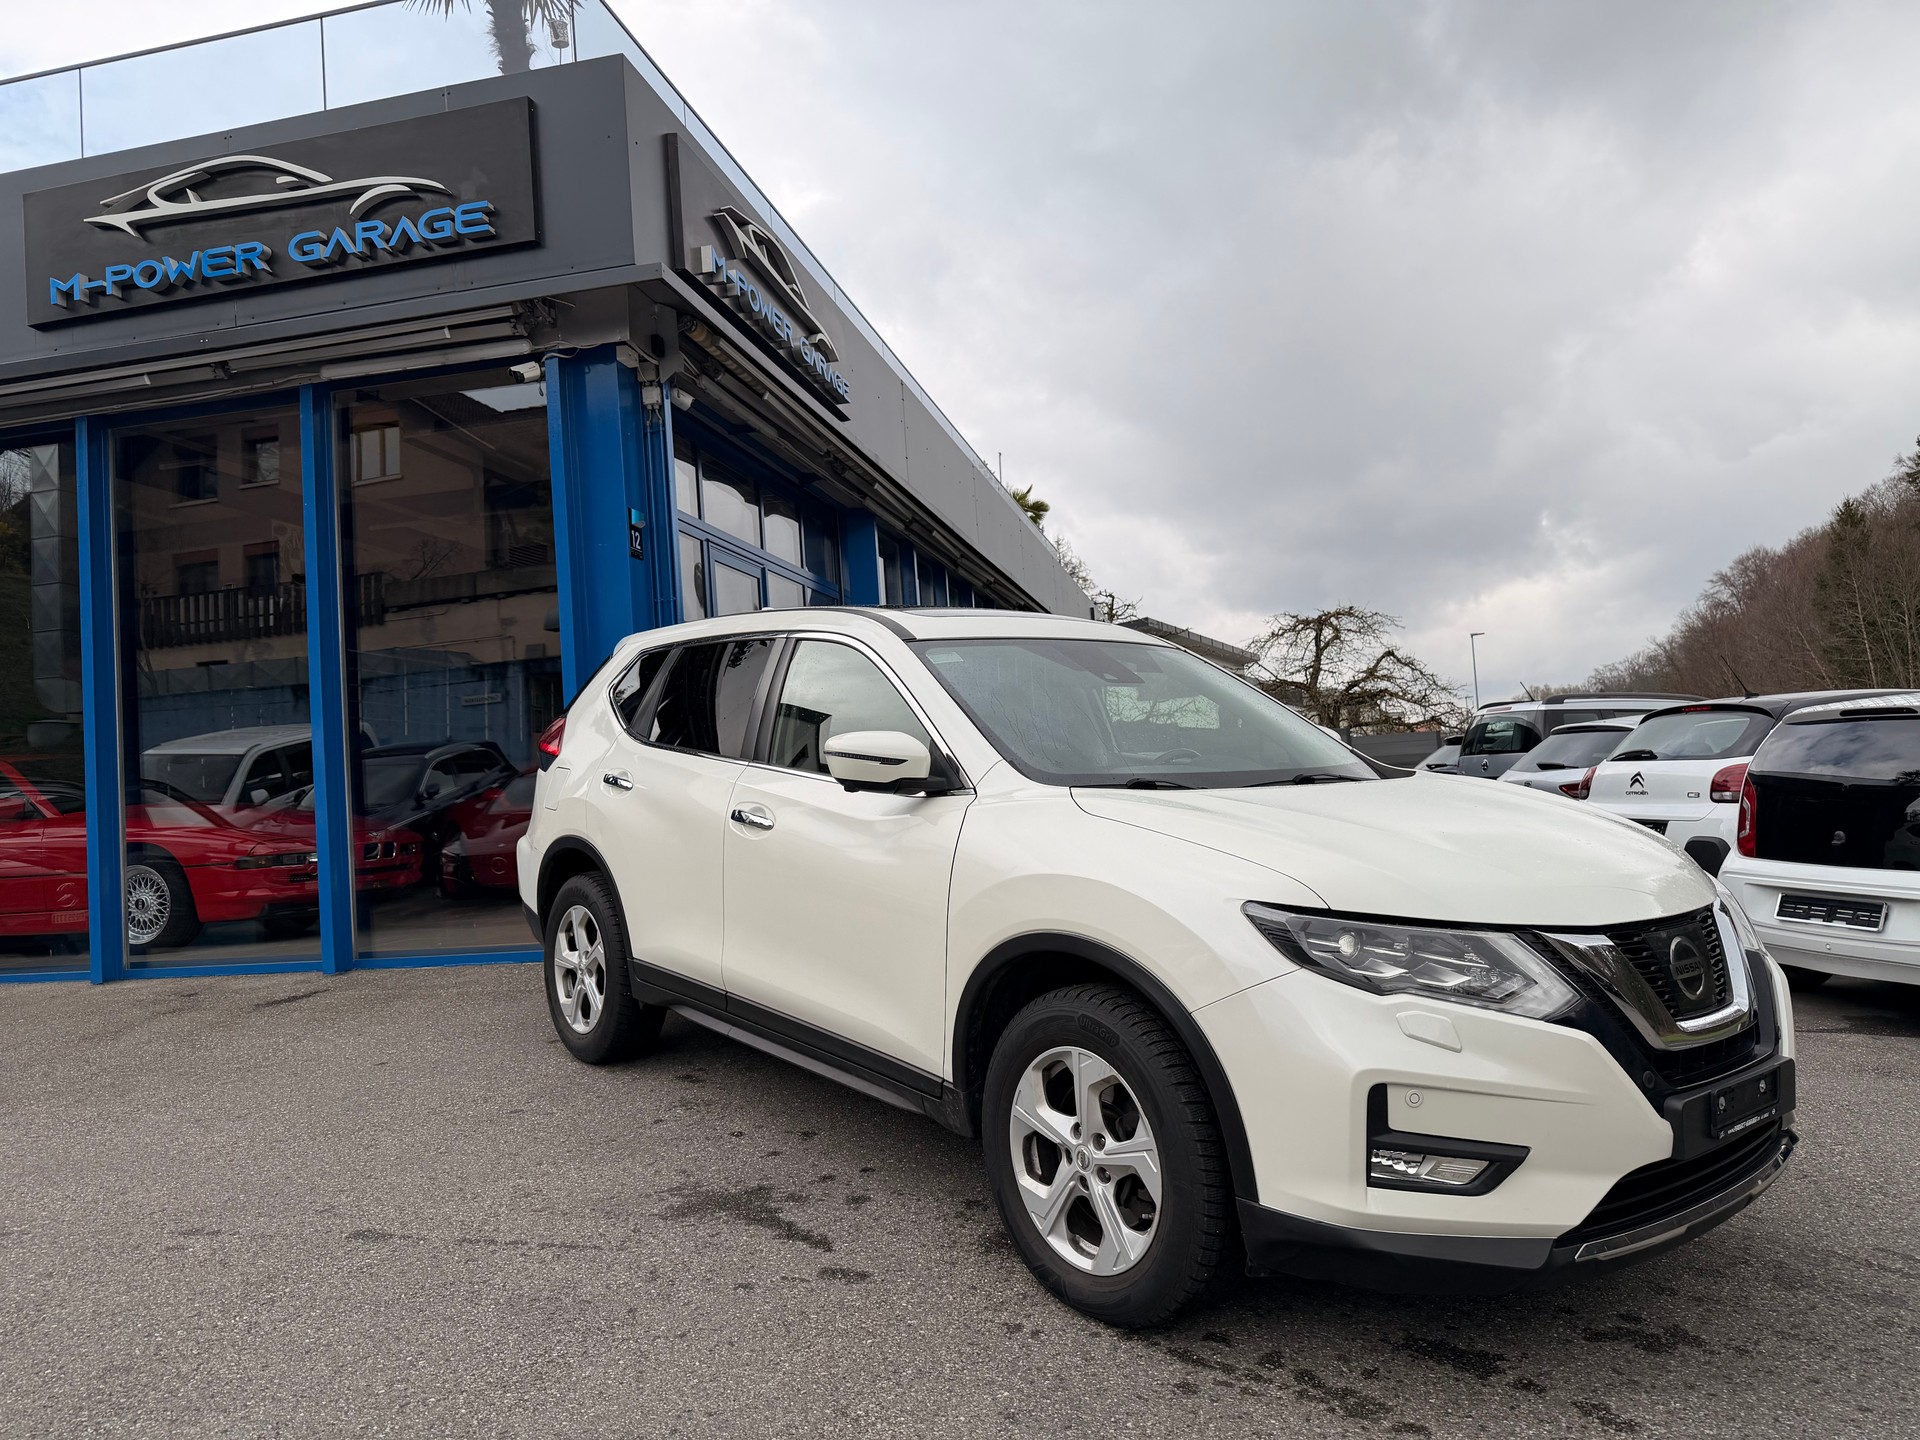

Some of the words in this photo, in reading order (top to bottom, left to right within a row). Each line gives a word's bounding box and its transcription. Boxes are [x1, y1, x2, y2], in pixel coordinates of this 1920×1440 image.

[49, 240, 267, 306] M-POWER
[287, 200, 491, 263] GARAGE
[711, 247, 794, 348] M-POWER
[799, 336, 851, 397] GARAGE
[631, 530, 641, 550] 12
